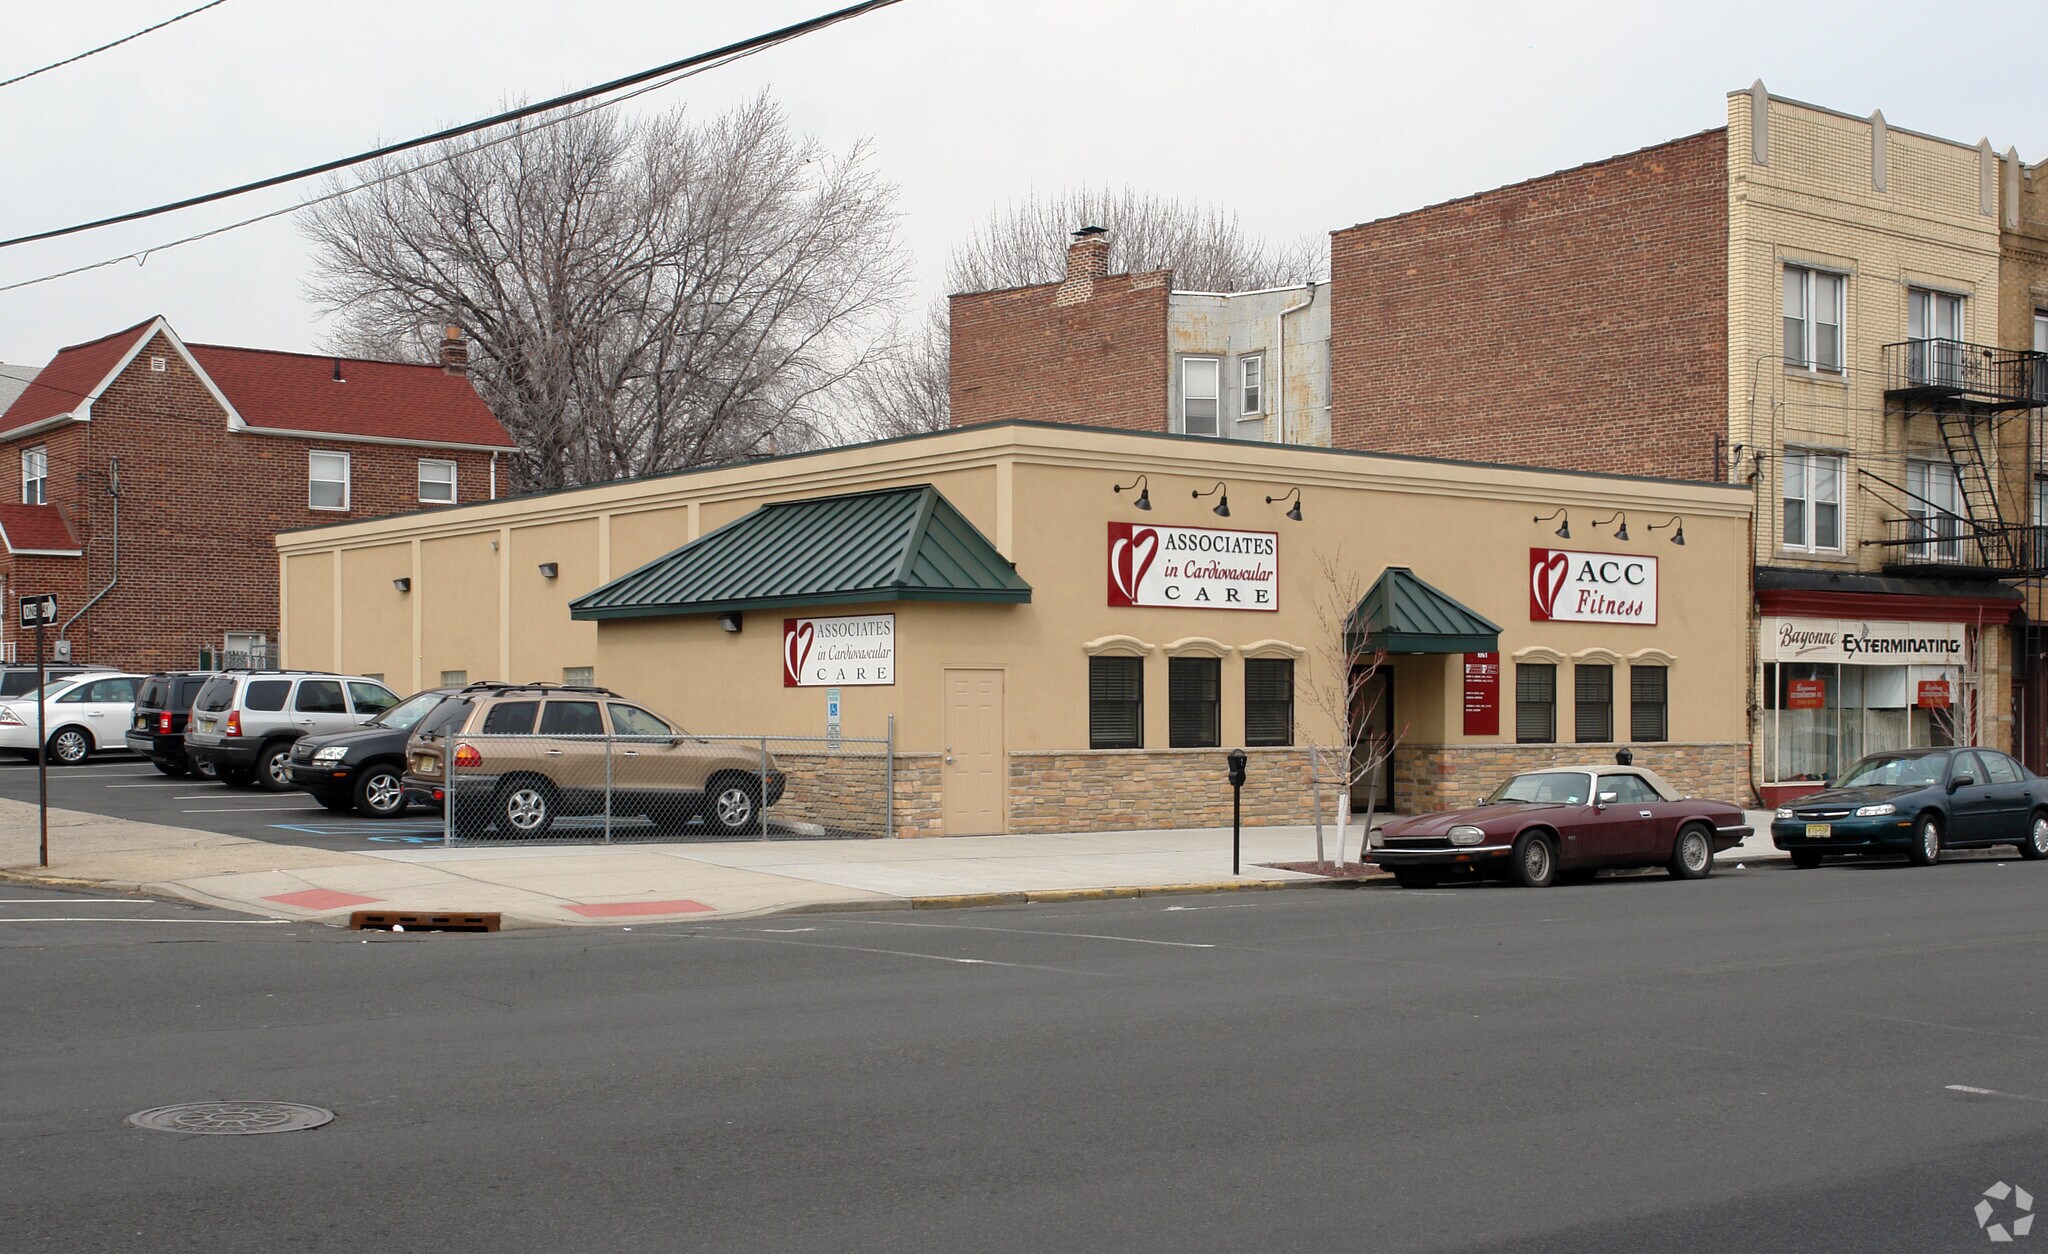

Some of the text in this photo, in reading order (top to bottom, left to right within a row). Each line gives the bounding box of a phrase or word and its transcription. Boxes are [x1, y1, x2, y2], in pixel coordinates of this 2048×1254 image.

[1165, 533, 1274, 555] ASSOCIATES
[1164, 559, 1274, 582] in Cardiovascular
[1575, 560, 1645, 585] ACC
[1165, 586, 1270, 604] CARE
[1575, 589, 1644, 616] Fitness
[817, 620, 891, 638] ASSOCIATES
[817, 642, 892, 661] in Cardiovascular
[1779, 622, 1961, 659] Bayonne EXTERMINATING
[816, 667, 887, 680] CARE
